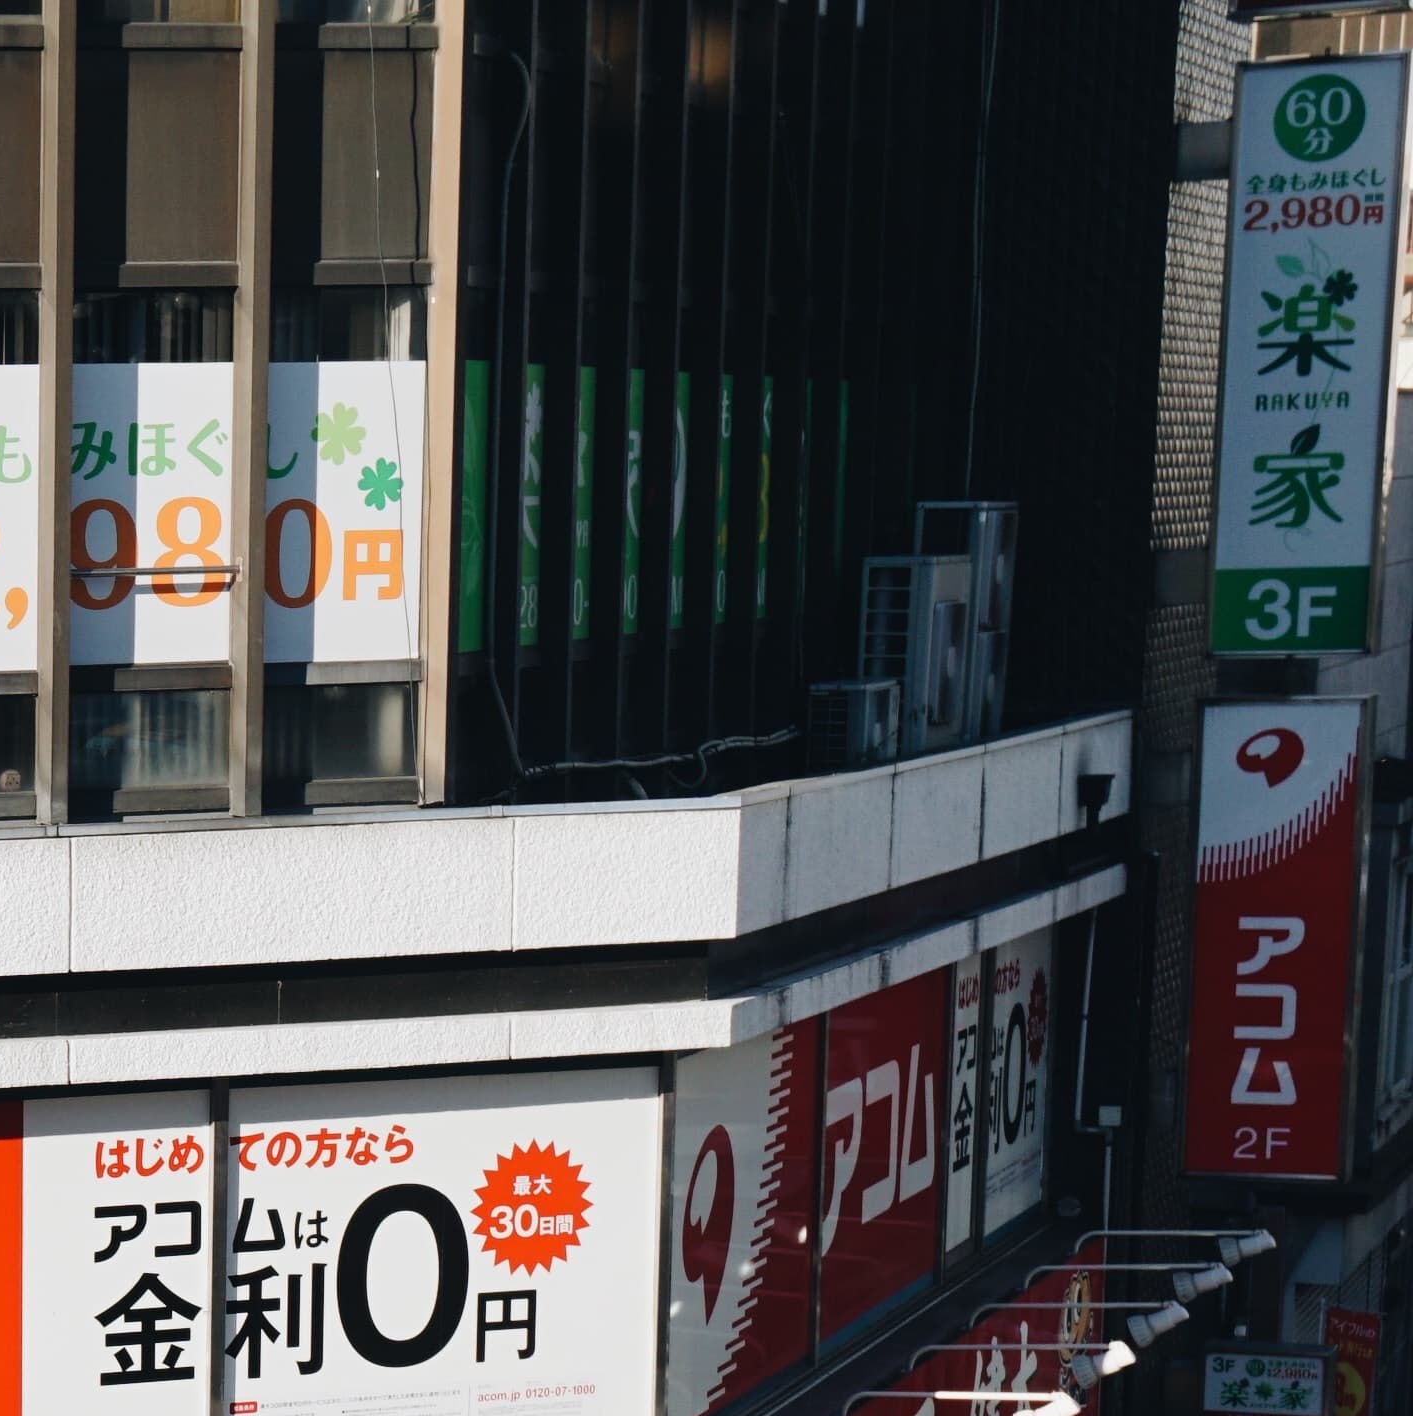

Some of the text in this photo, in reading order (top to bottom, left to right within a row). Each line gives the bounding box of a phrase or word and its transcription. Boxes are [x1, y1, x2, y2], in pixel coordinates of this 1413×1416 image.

[1286, 88, 1352, 128] 60
[1304, 127, 1333, 155] 分
[1246, 168, 1386, 195] 全身もみほぐし
[1243, 193, 1384, 233] 2,980円
[1255, 391, 1351, 413] RAKUYA
[1245, 578, 1338, 640] 3F
[1230, 915, 1306, 1106] アコム
[95, 1125, 415, 1178] はじめての方なら
[822, 1043, 935, 1257] アコム
[1232, 1126, 1292, 1160] 2F
[513, 1174, 552, 1196] 最大
[94, 1197, 330, 1263] アコムは
[489, 1204, 574, 1239] 30日間
[1212, 1357, 1235, 1373] 3F
[478, 1383, 596, 1403] acom.jp 0120-07-1000
